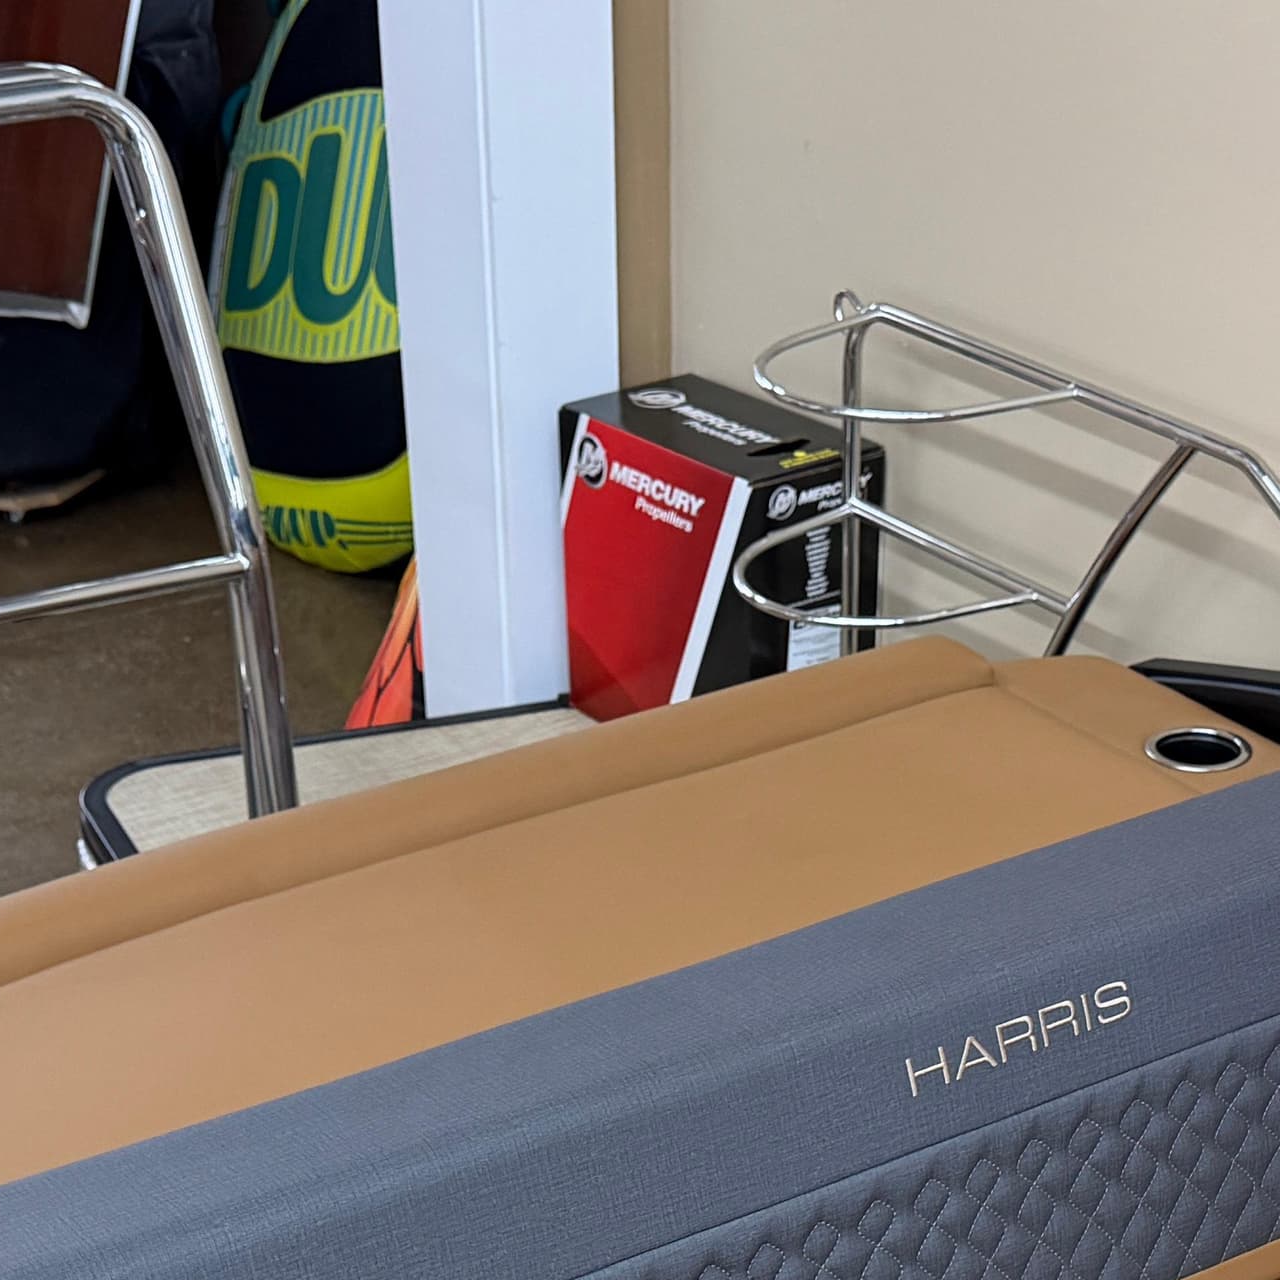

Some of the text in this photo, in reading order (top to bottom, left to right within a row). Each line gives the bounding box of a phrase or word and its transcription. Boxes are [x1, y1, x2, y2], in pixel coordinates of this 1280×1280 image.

[671, 405, 781, 443] MERCURY
[609, 461, 706, 517] MERCURY
[634, 496, 694, 533] Propellers
[904, 980, 1132, 1097] HARRIS
